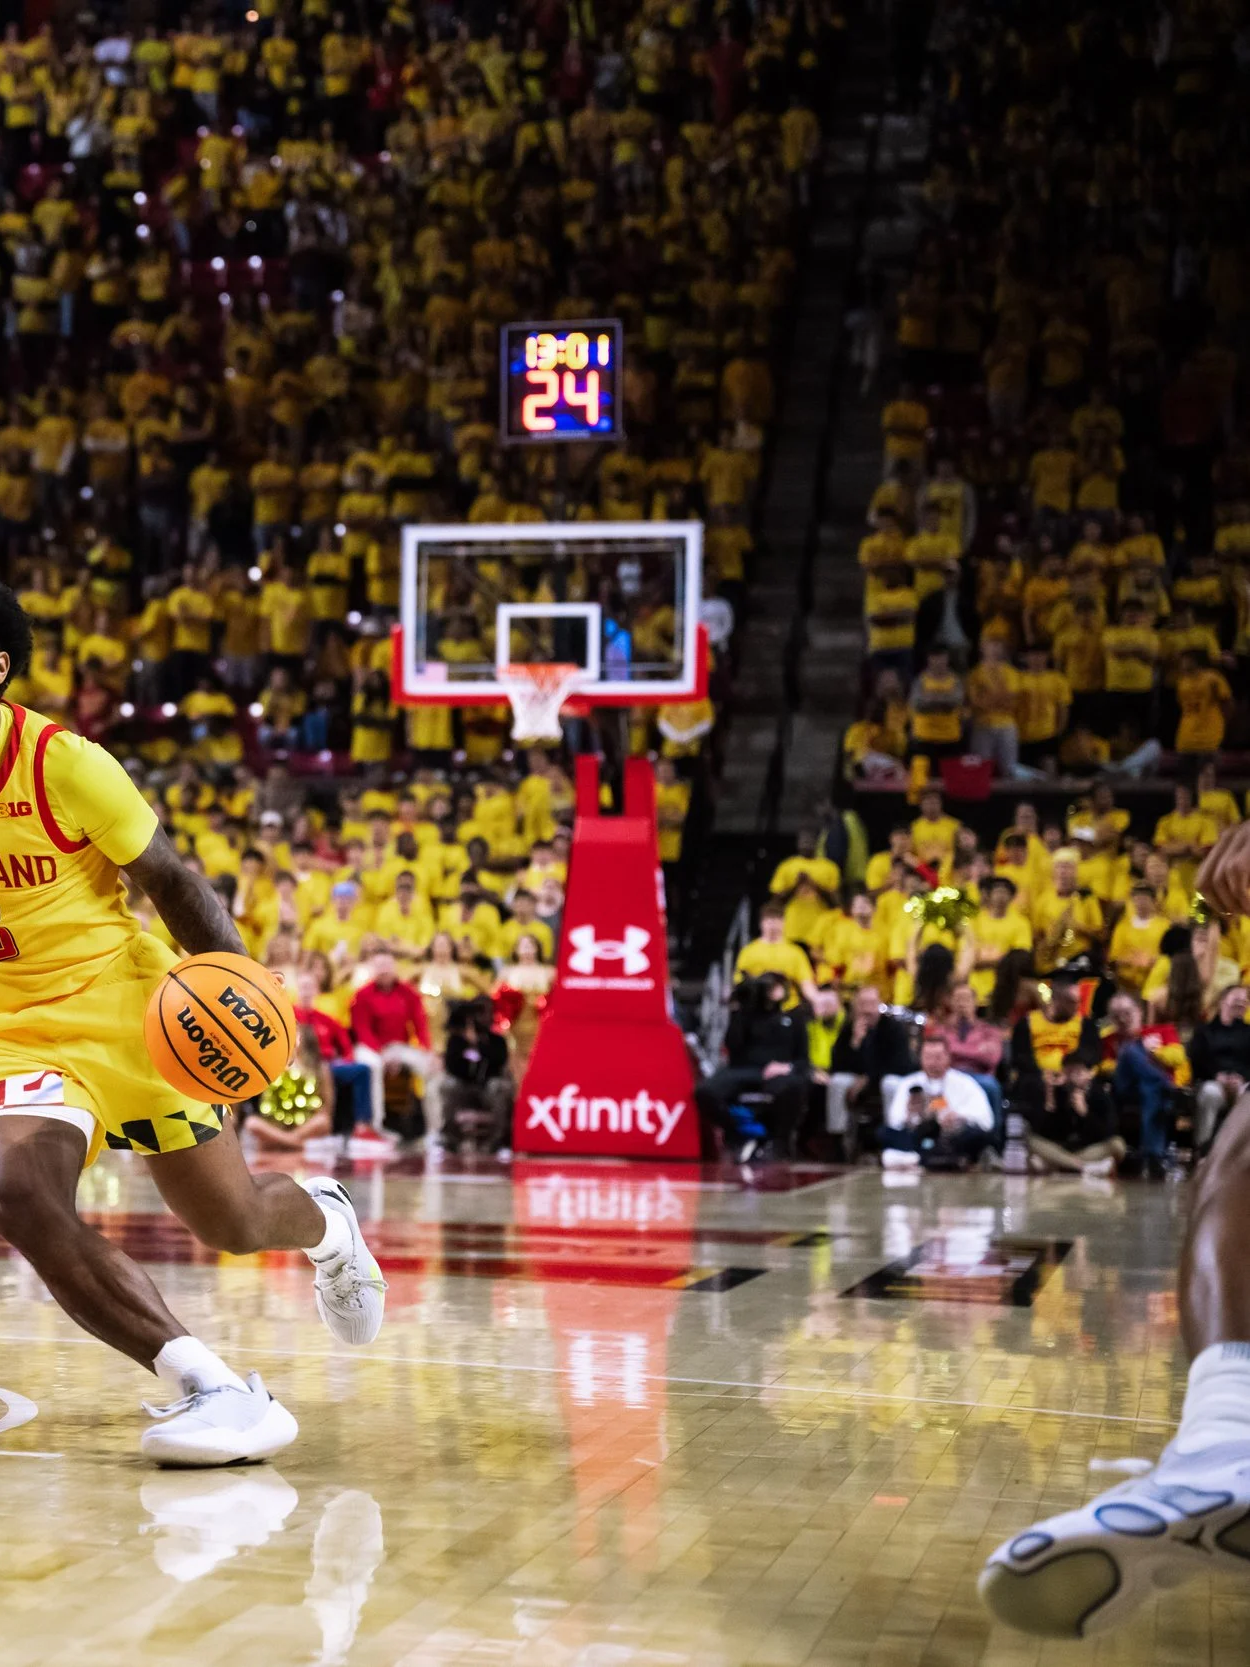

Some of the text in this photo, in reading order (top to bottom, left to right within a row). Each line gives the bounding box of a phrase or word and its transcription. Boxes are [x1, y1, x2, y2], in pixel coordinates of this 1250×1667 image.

[525, 332, 610, 370] 13:01
[523, 369, 600, 431] 24
[176, 1006, 250, 1092] Wilson
[217, 986, 277, 1050] NCAA
[526, 1083, 686, 1146] xfinity
